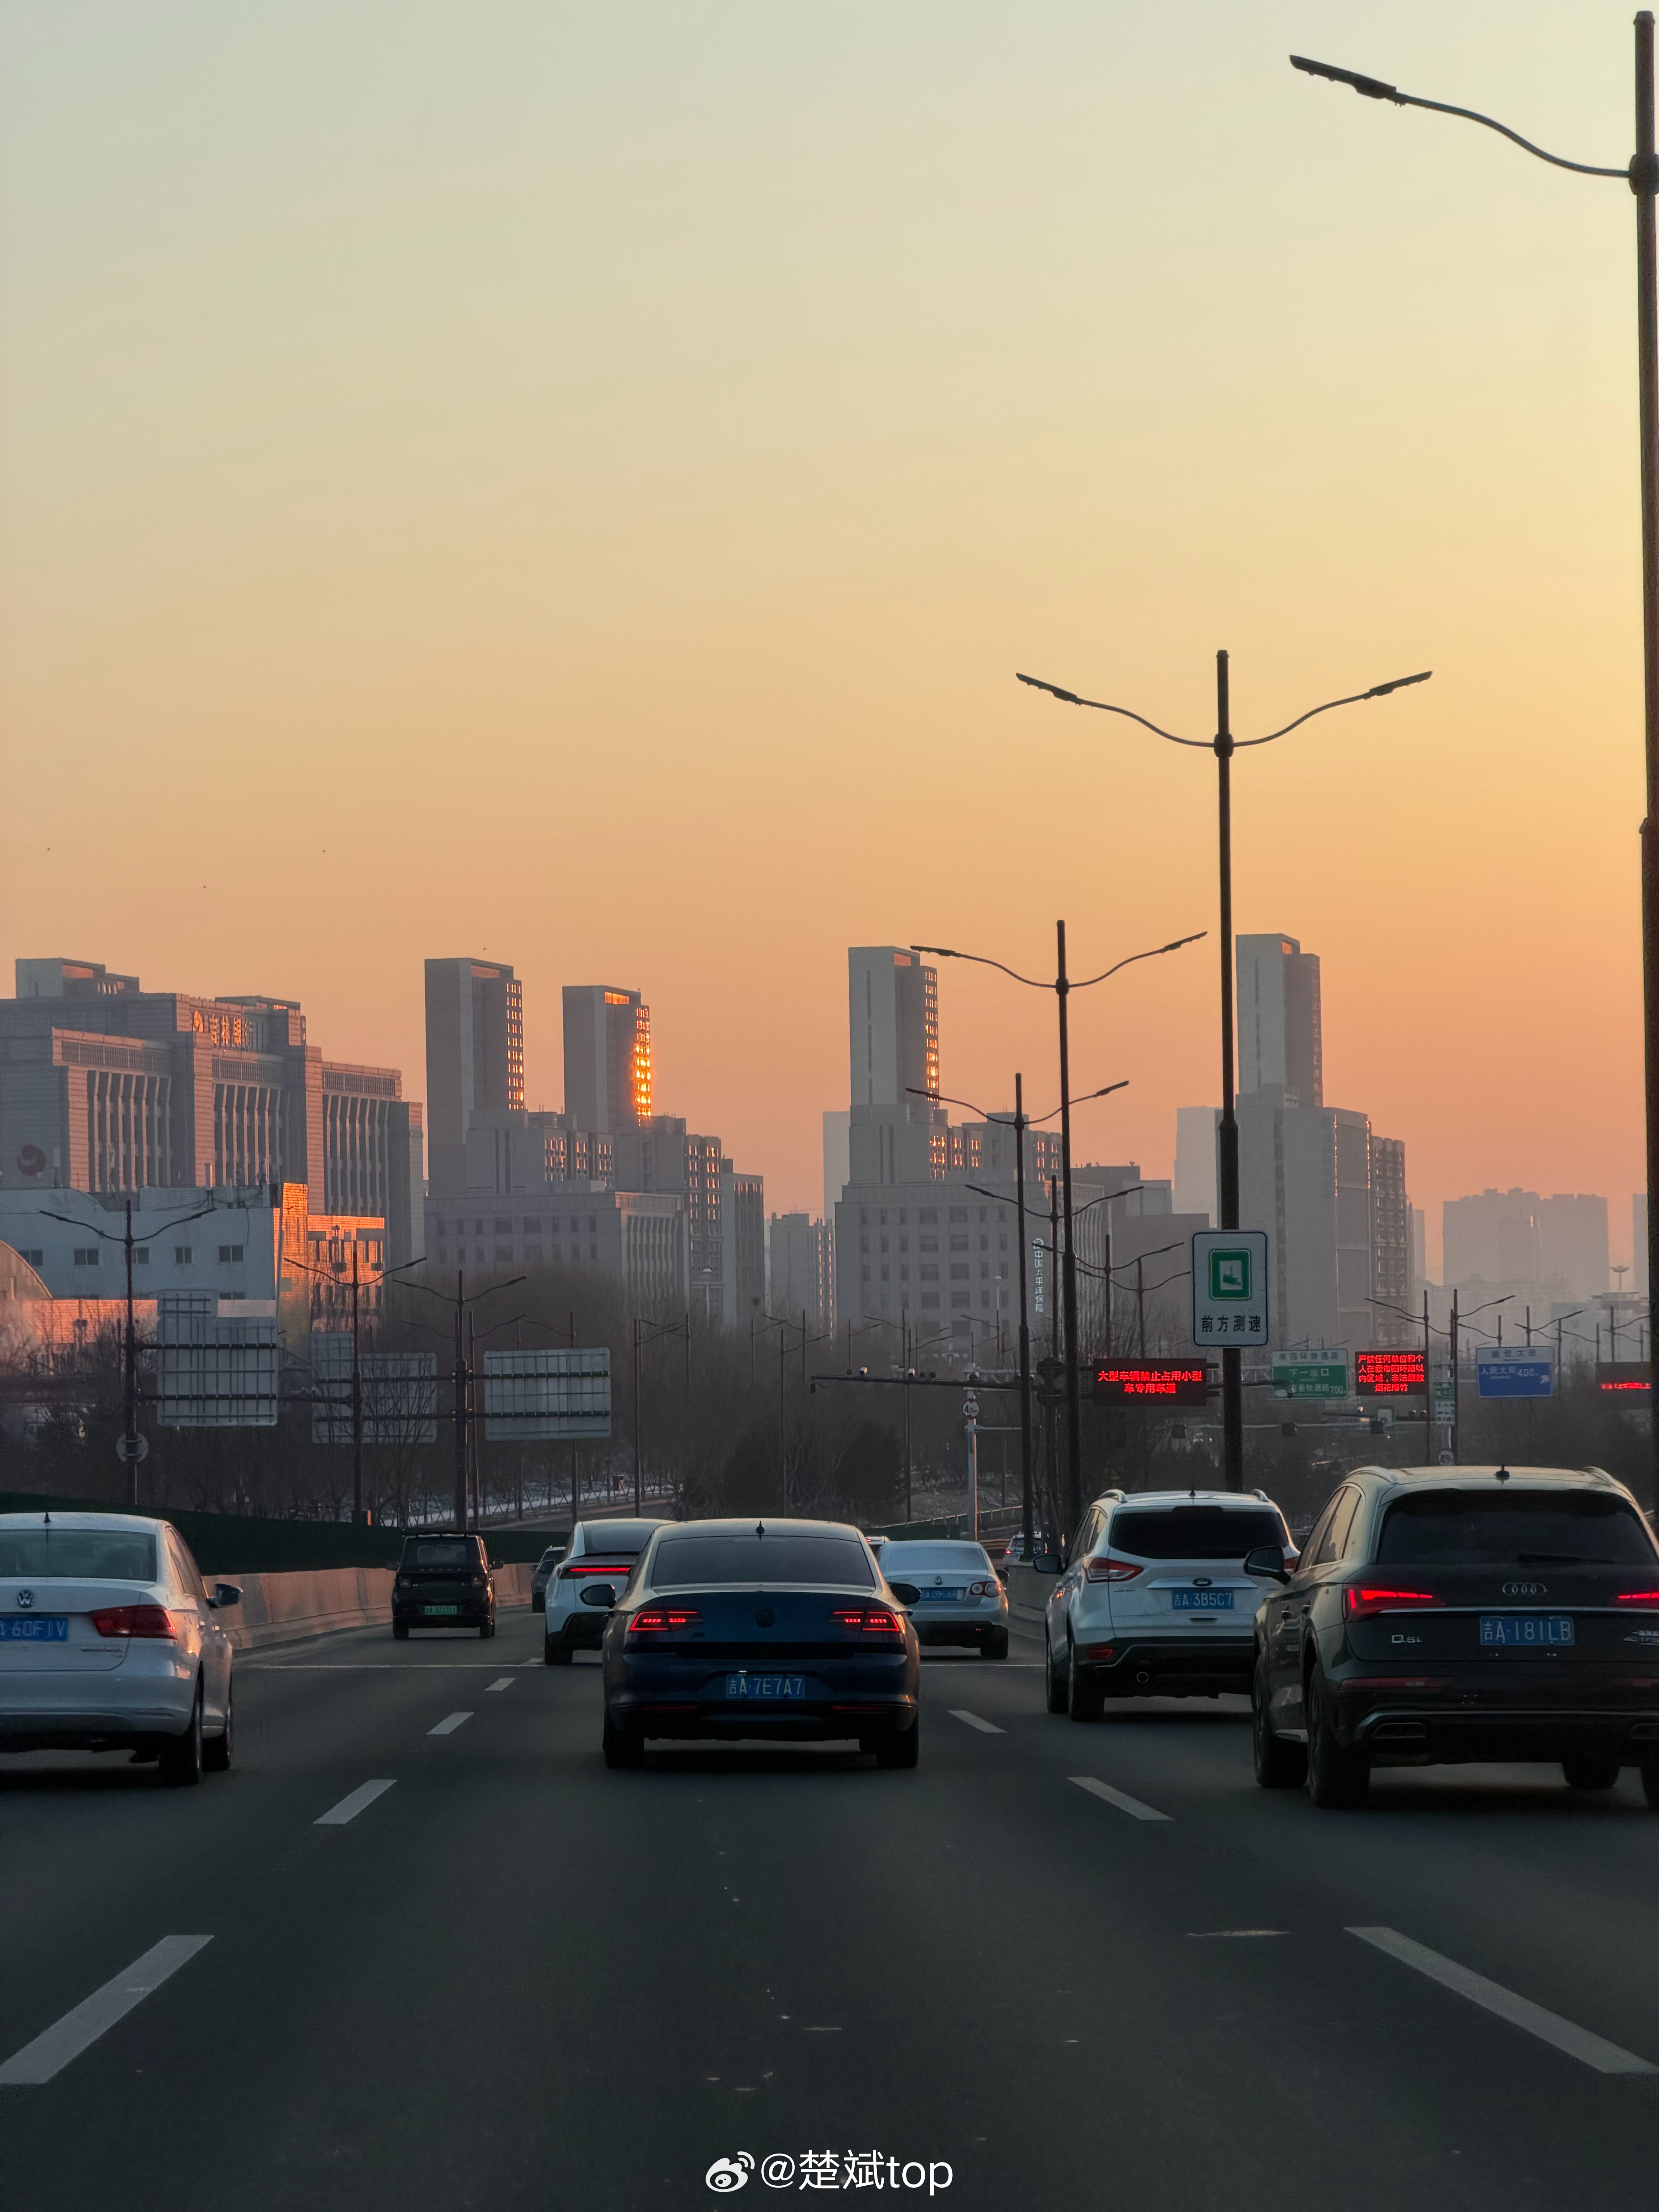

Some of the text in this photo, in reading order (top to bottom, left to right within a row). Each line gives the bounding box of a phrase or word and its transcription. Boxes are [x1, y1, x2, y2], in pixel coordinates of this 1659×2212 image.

[1034, 1250, 1044, 1312] 中国太平洋保险
[1201, 1315, 1261, 1332] 前方测速
[1358, 1355, 1424, 1363] 严禁任何单位和个
[1289, 1368, 1329, 1377] 下一出口
[1358, 1364, 1424, 1373] 人在我市四环路以
[1097, 1370, 1202, 1381] 大型车辆禁止占用小型
[1124, 1383, 1176, 1394] 车专用车道
[1375, 1383, 1408, 1392] 烟花爆竹
